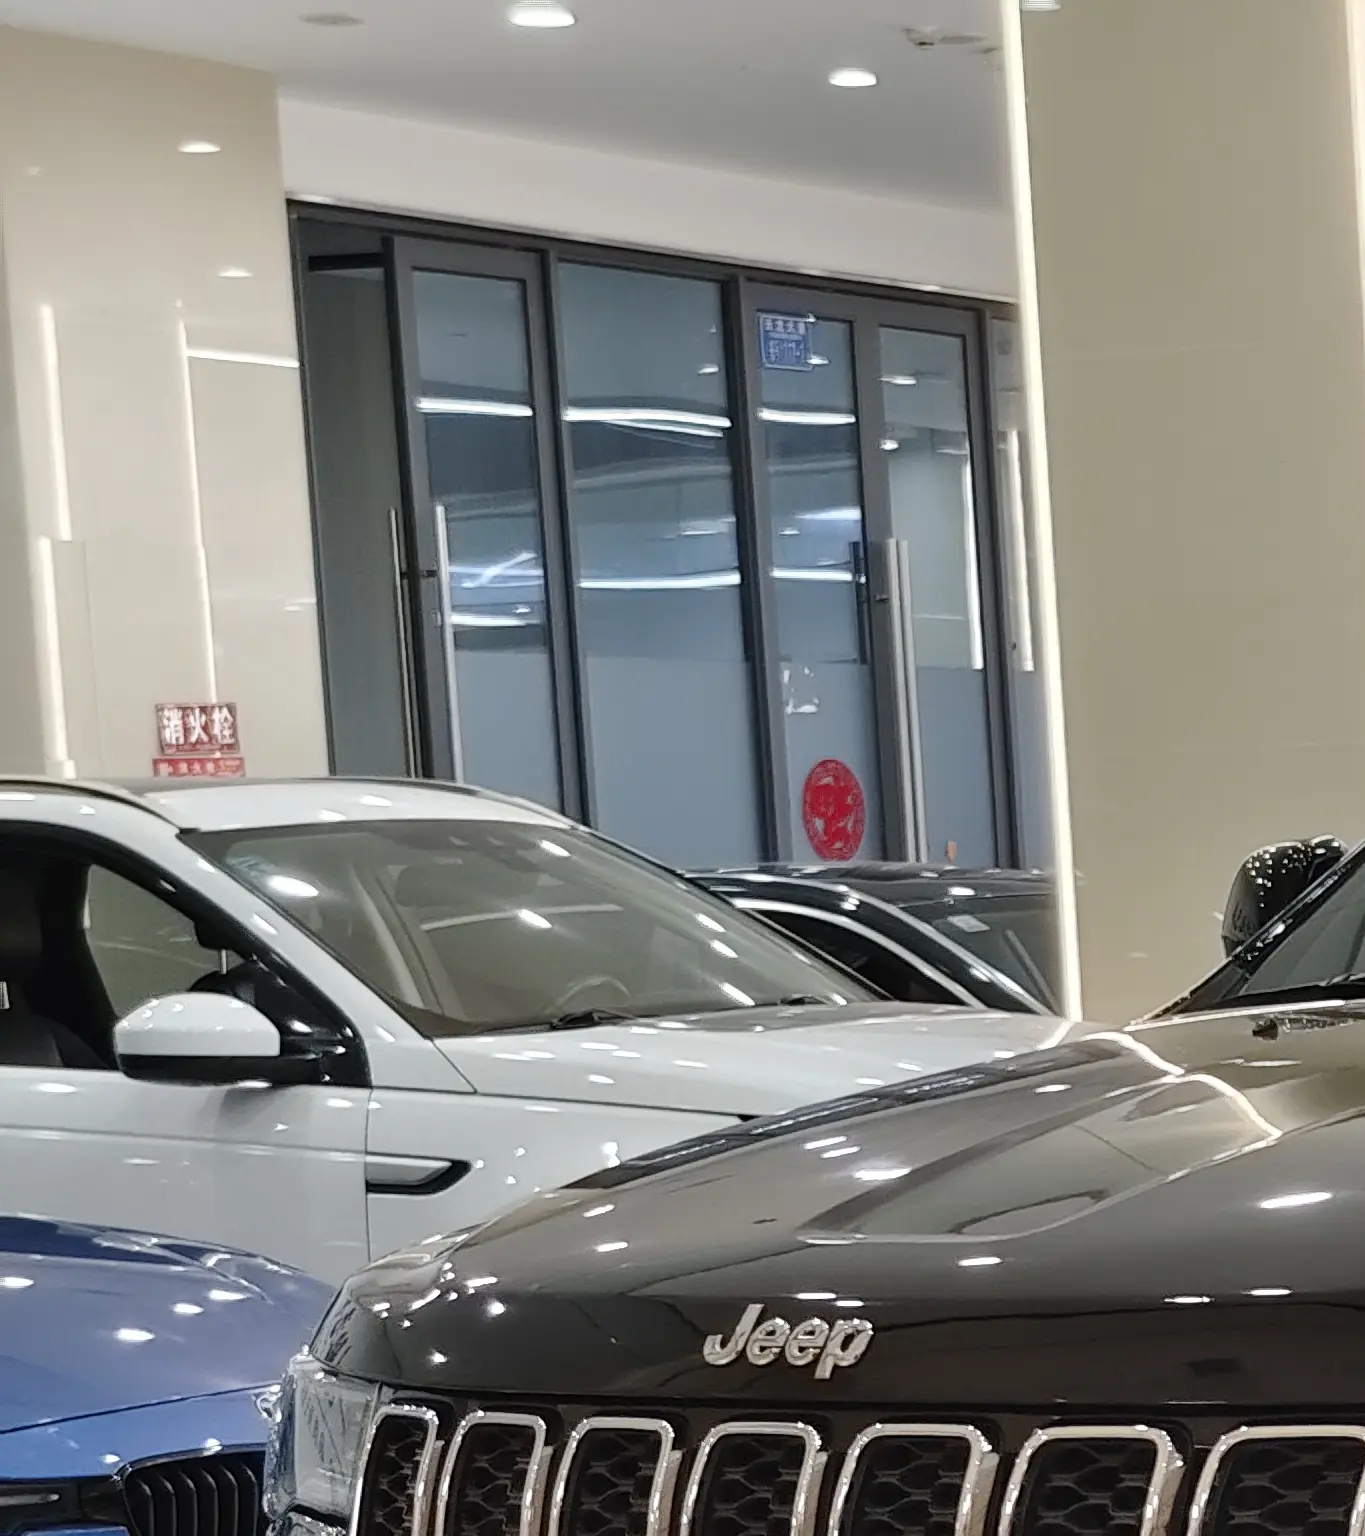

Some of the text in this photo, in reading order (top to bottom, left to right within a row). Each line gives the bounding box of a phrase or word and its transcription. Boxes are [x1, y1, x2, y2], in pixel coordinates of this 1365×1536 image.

[162, 706, 236, 745] 消火栓
[703, 1303, 874, 1379] Jeep
